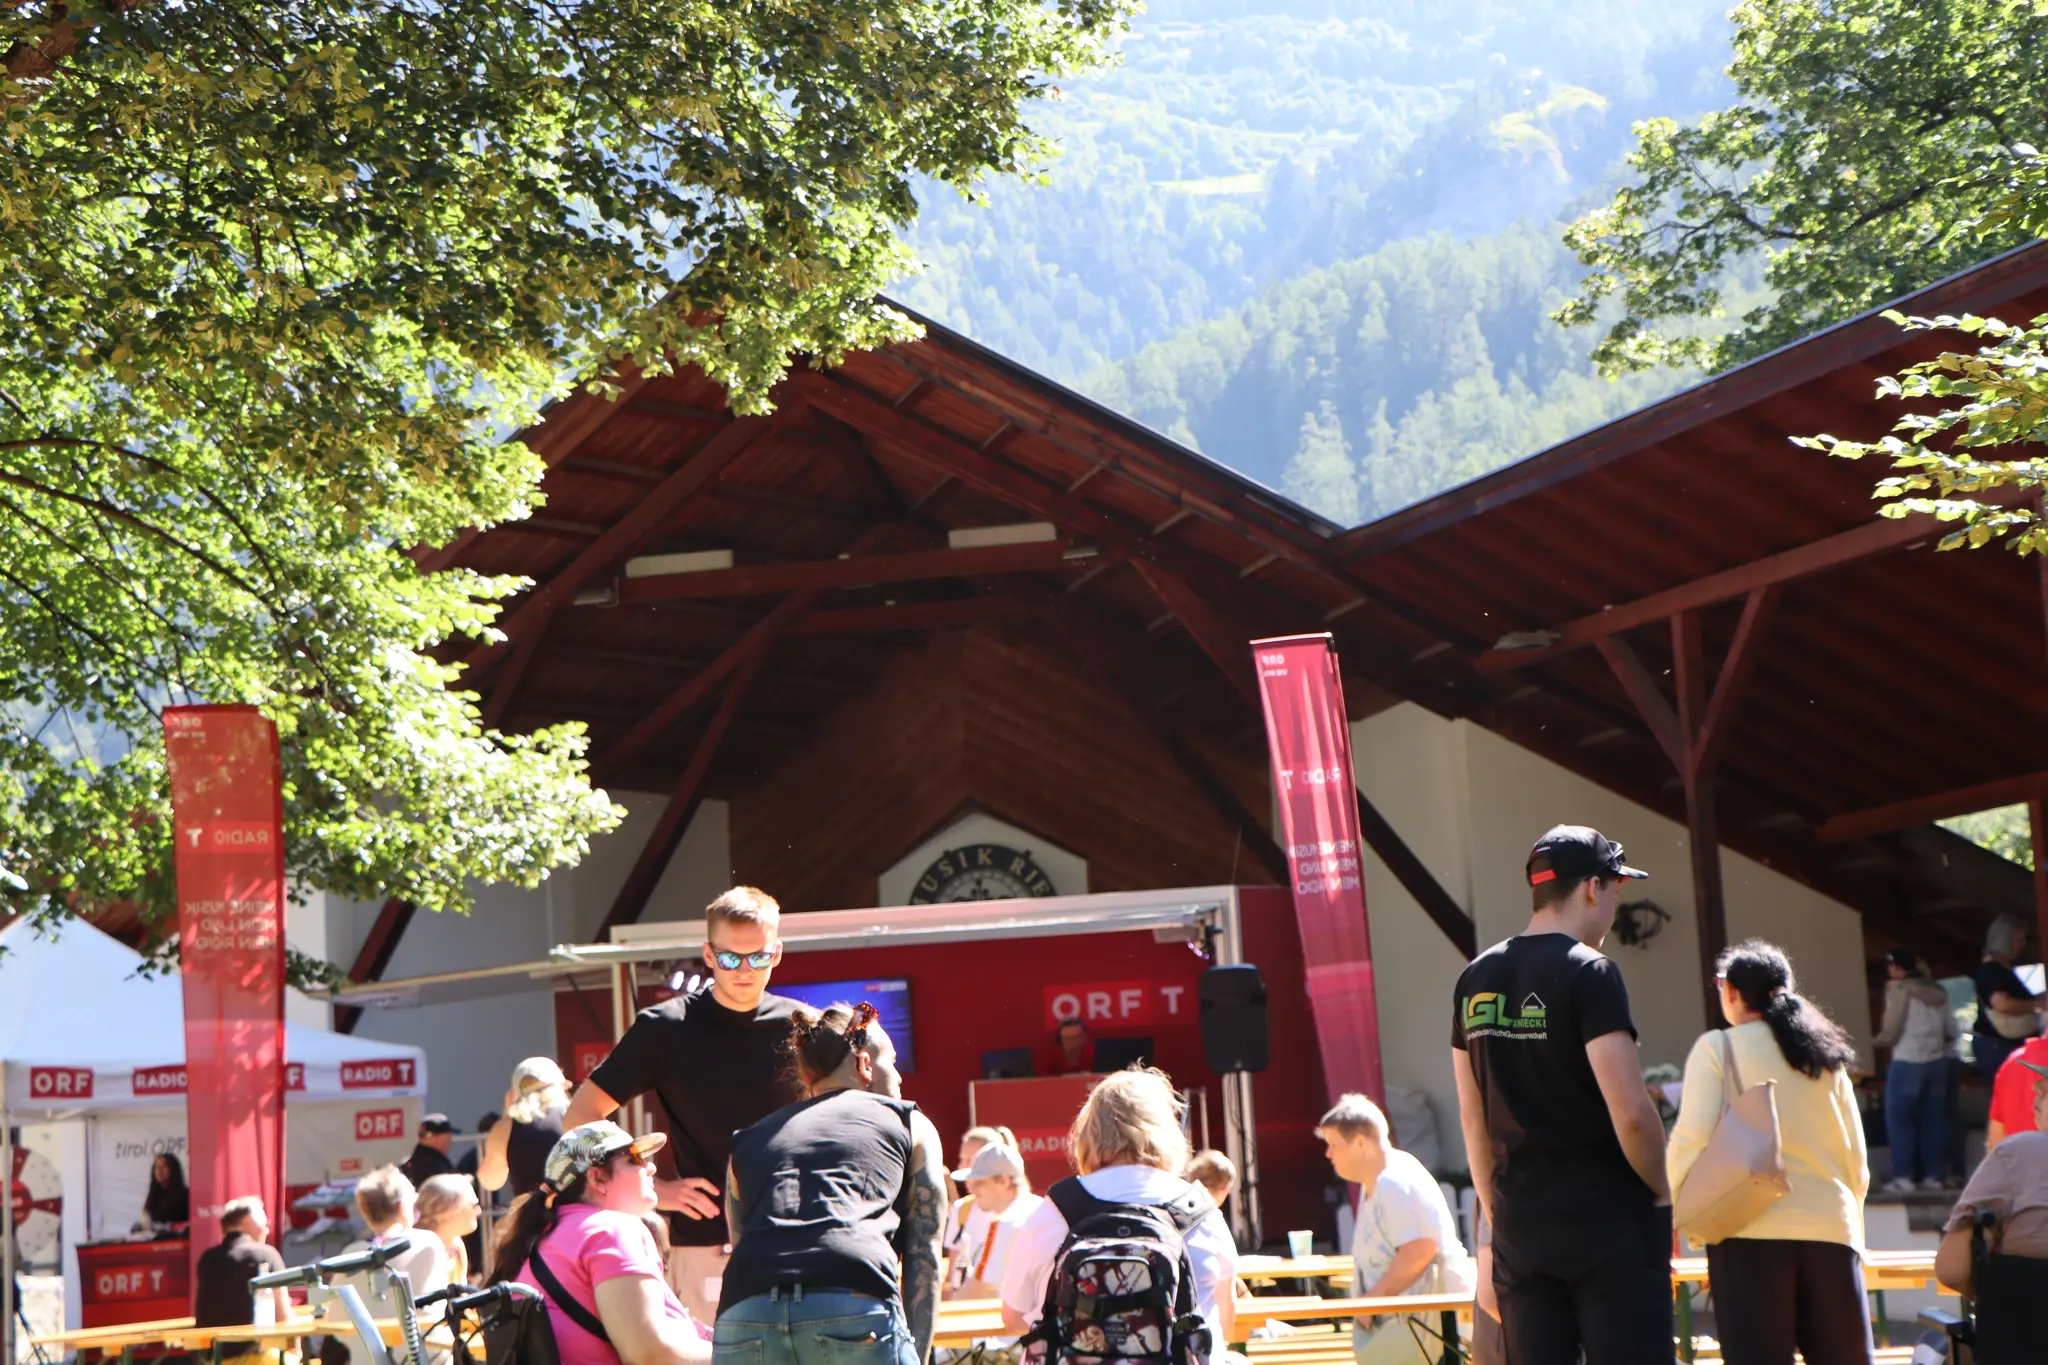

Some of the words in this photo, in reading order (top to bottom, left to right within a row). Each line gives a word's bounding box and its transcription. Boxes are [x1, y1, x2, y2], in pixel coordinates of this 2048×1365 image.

[914, 847, 993, 904] USIK
[1052, 989, 1143, 1020] ORF
[1160, 986, 1184, 1015] T
[34, 1071, 91, 1094] ORF
[343, 1066, 392, 1082] RADIO
[397, 1062, 411, 1084] T
[358, 1114, 401, 1136] ORF
[1020, 1136, 1068, 1152] RADI
[99, 1272, 143, 1295] ORF
[152, 1270, 163, 1293] T
